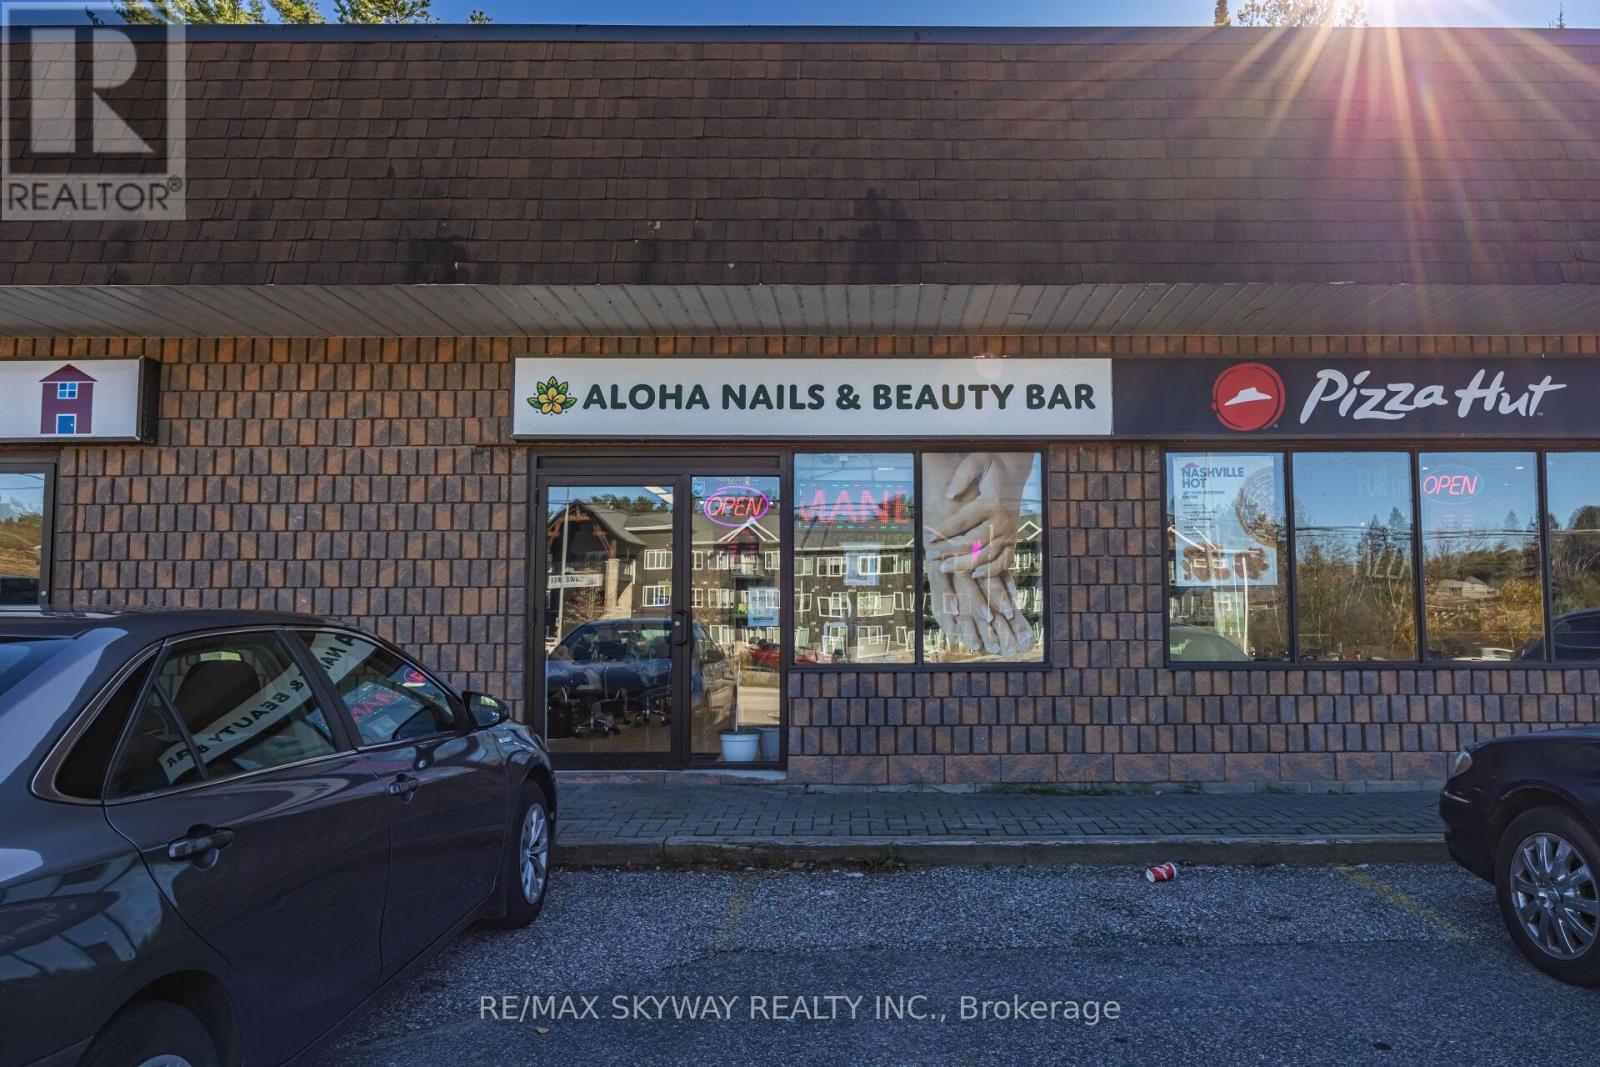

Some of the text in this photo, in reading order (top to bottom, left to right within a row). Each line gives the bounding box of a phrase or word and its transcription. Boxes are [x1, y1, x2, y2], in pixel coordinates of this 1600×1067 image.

[583, 383, 1096, 410] ALOHA NAILS & BEAUTY BAR
[1299, 368, 1568, 424] Pizza Hut
[1182, 467, 1245, 477] NASHVILLE
[1182, 479, 1207, 488] HOT
[1423, 475, 1478, 495] OPEN
[707, 496, 763, 517] OPEN
